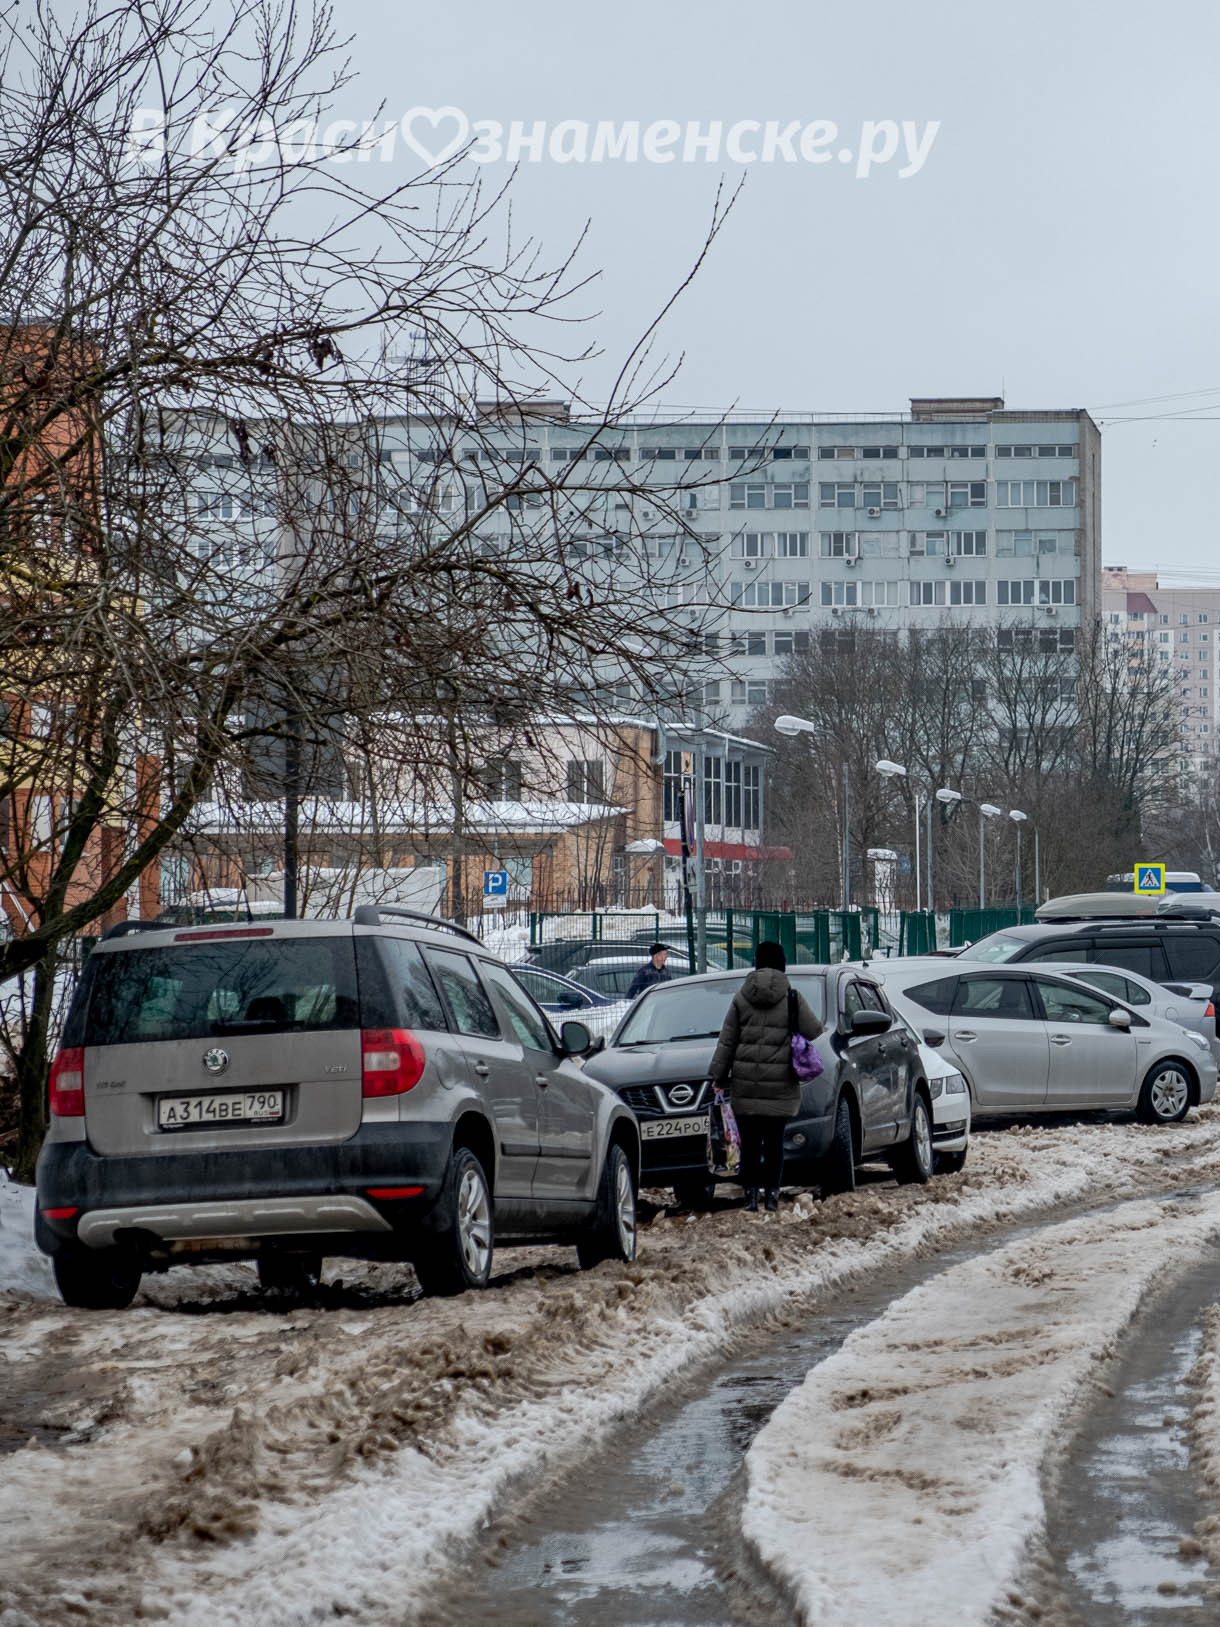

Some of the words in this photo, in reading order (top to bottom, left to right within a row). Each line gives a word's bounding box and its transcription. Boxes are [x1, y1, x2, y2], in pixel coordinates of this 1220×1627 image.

[166, 1098, 242, 1122] А314ВЕ
[246, 1094, 277, 1111] 790
[646, 1121, 701, 1138] Е224РО
